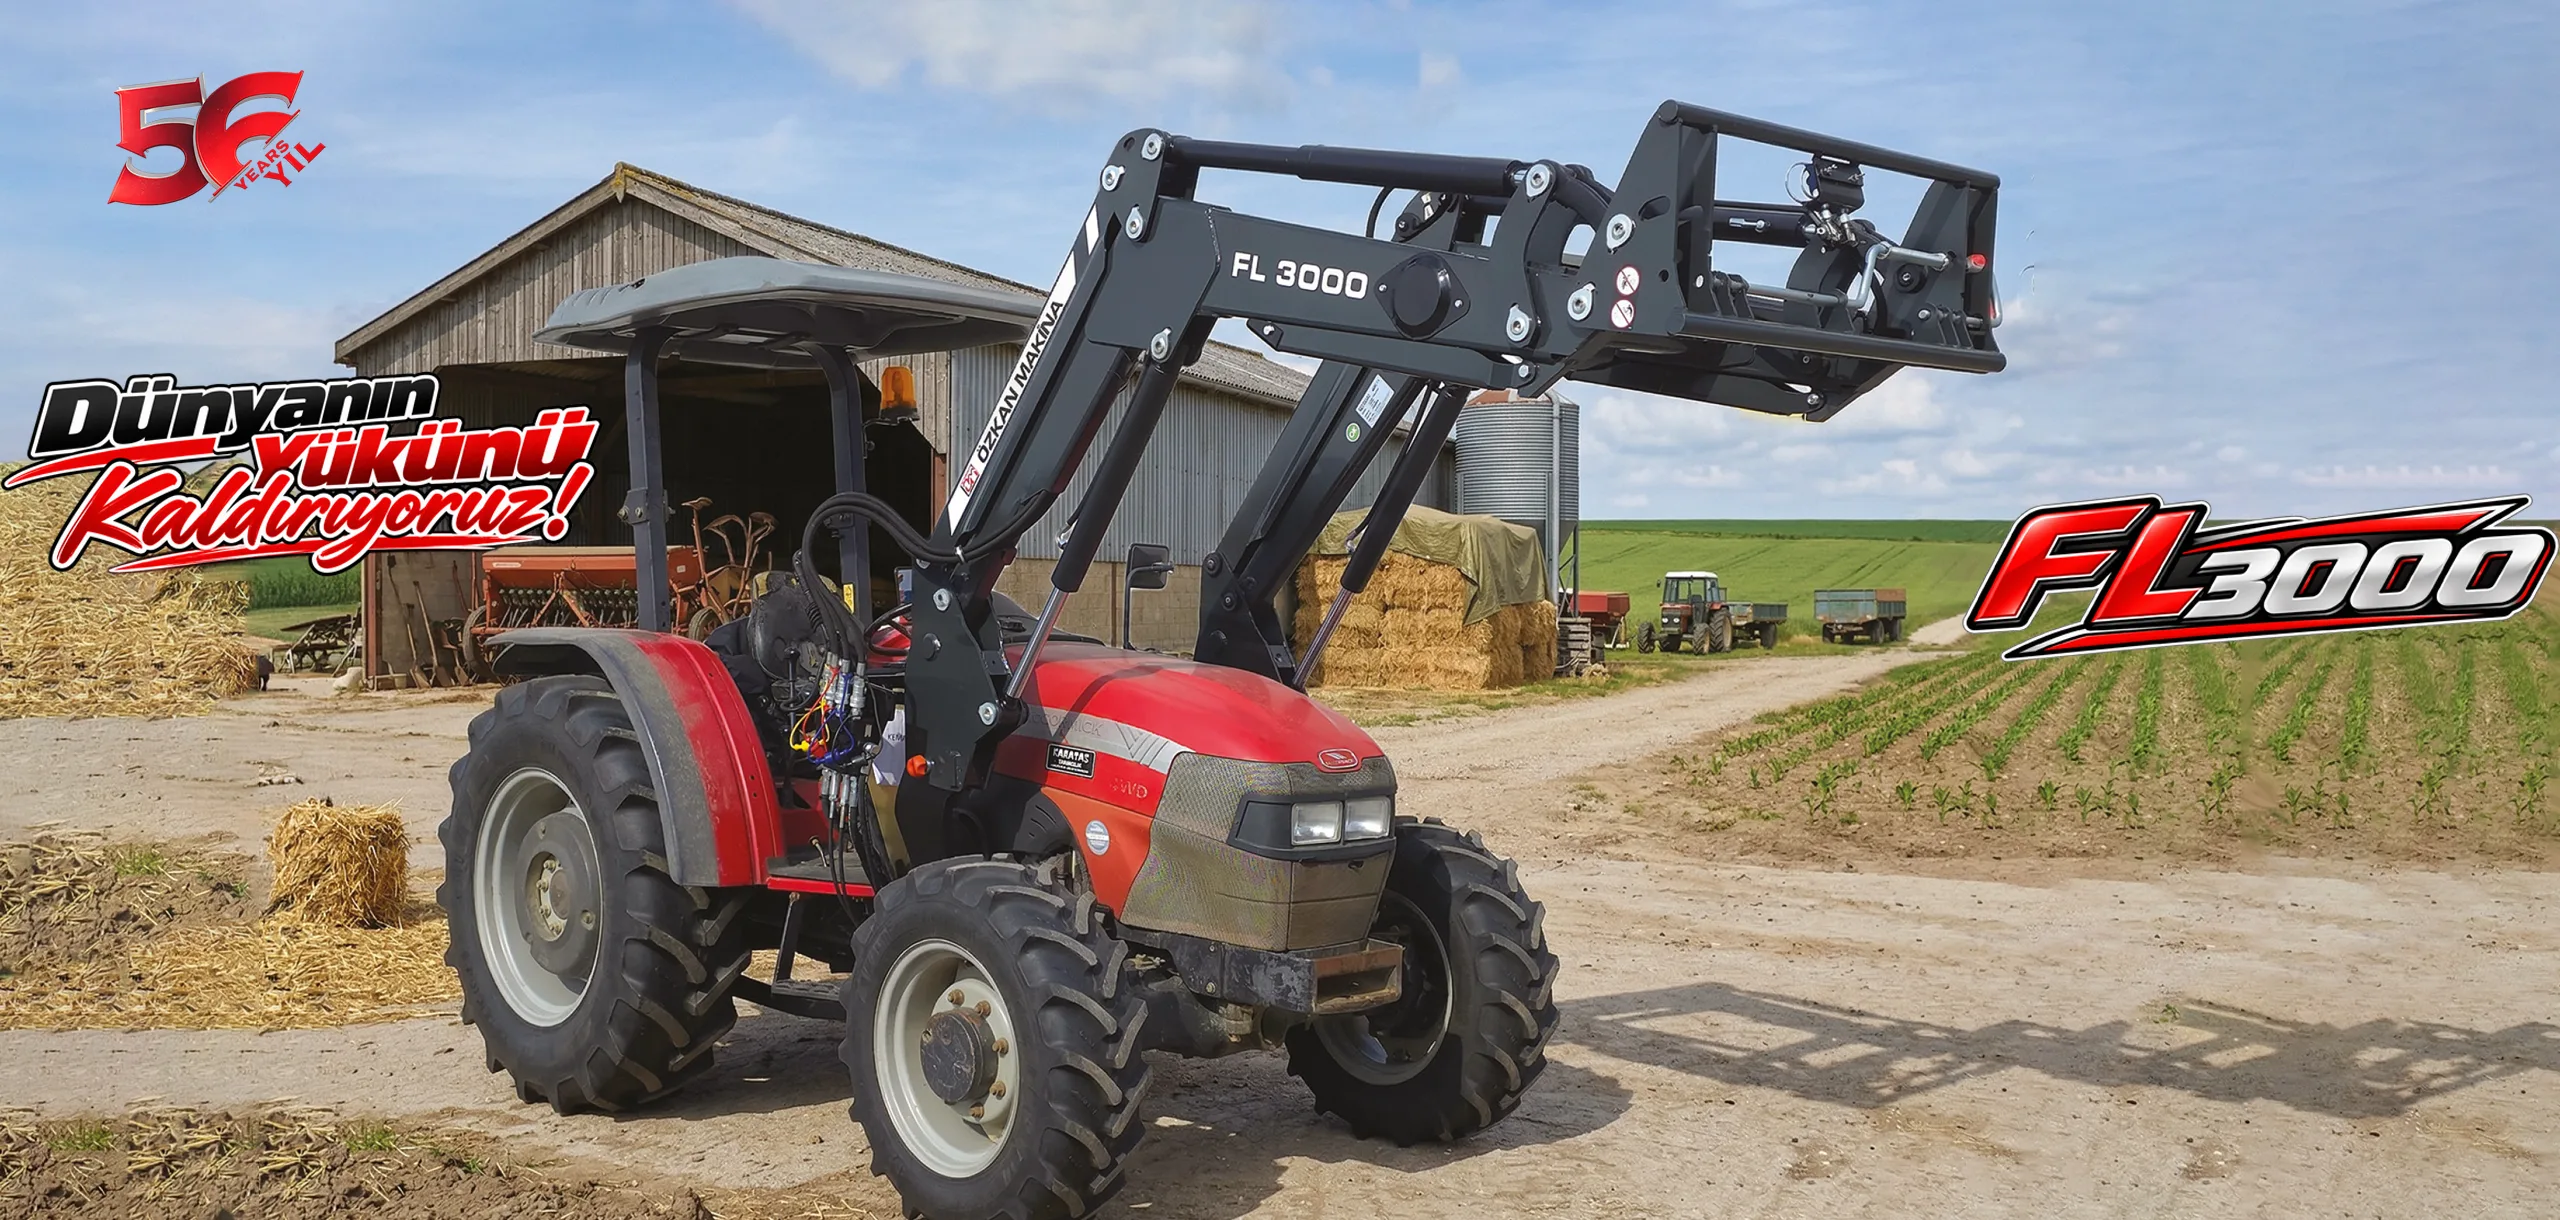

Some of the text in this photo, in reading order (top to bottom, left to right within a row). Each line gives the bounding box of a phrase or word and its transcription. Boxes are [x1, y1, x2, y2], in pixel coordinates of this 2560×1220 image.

[1231, 251, 1369, 300] FL 3000
[976, 300, 1064, 464] ÖZKAN MAKİNA
